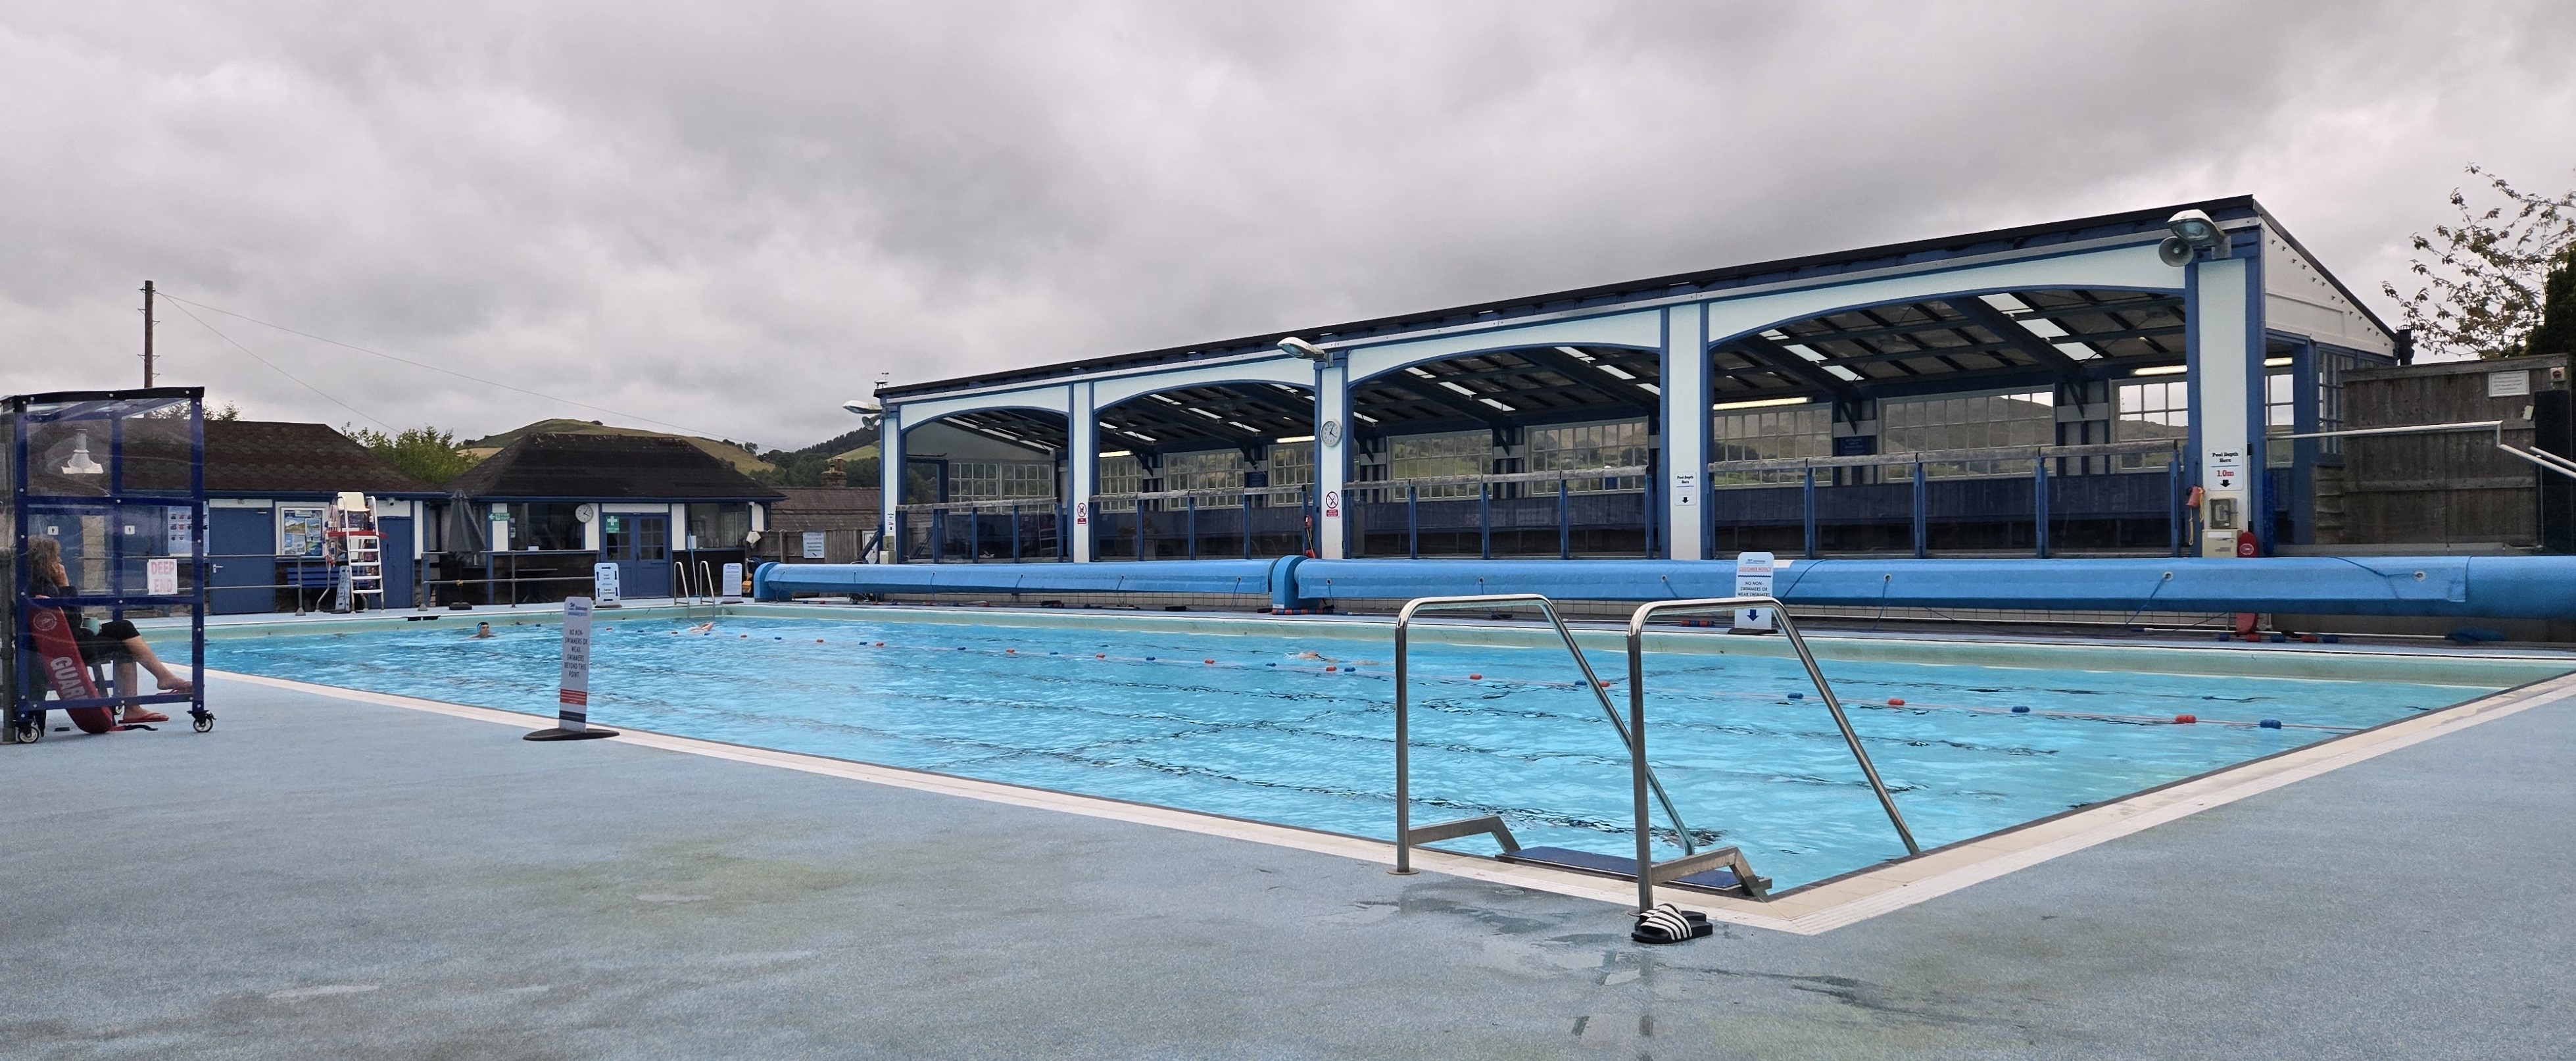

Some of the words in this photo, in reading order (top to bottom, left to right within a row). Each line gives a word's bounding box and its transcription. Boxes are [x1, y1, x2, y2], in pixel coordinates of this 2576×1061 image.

[151, 561, 175, 575] DEEP
[155, 579, 172, 593] END
[50, 656, 89, 700] GUAR
